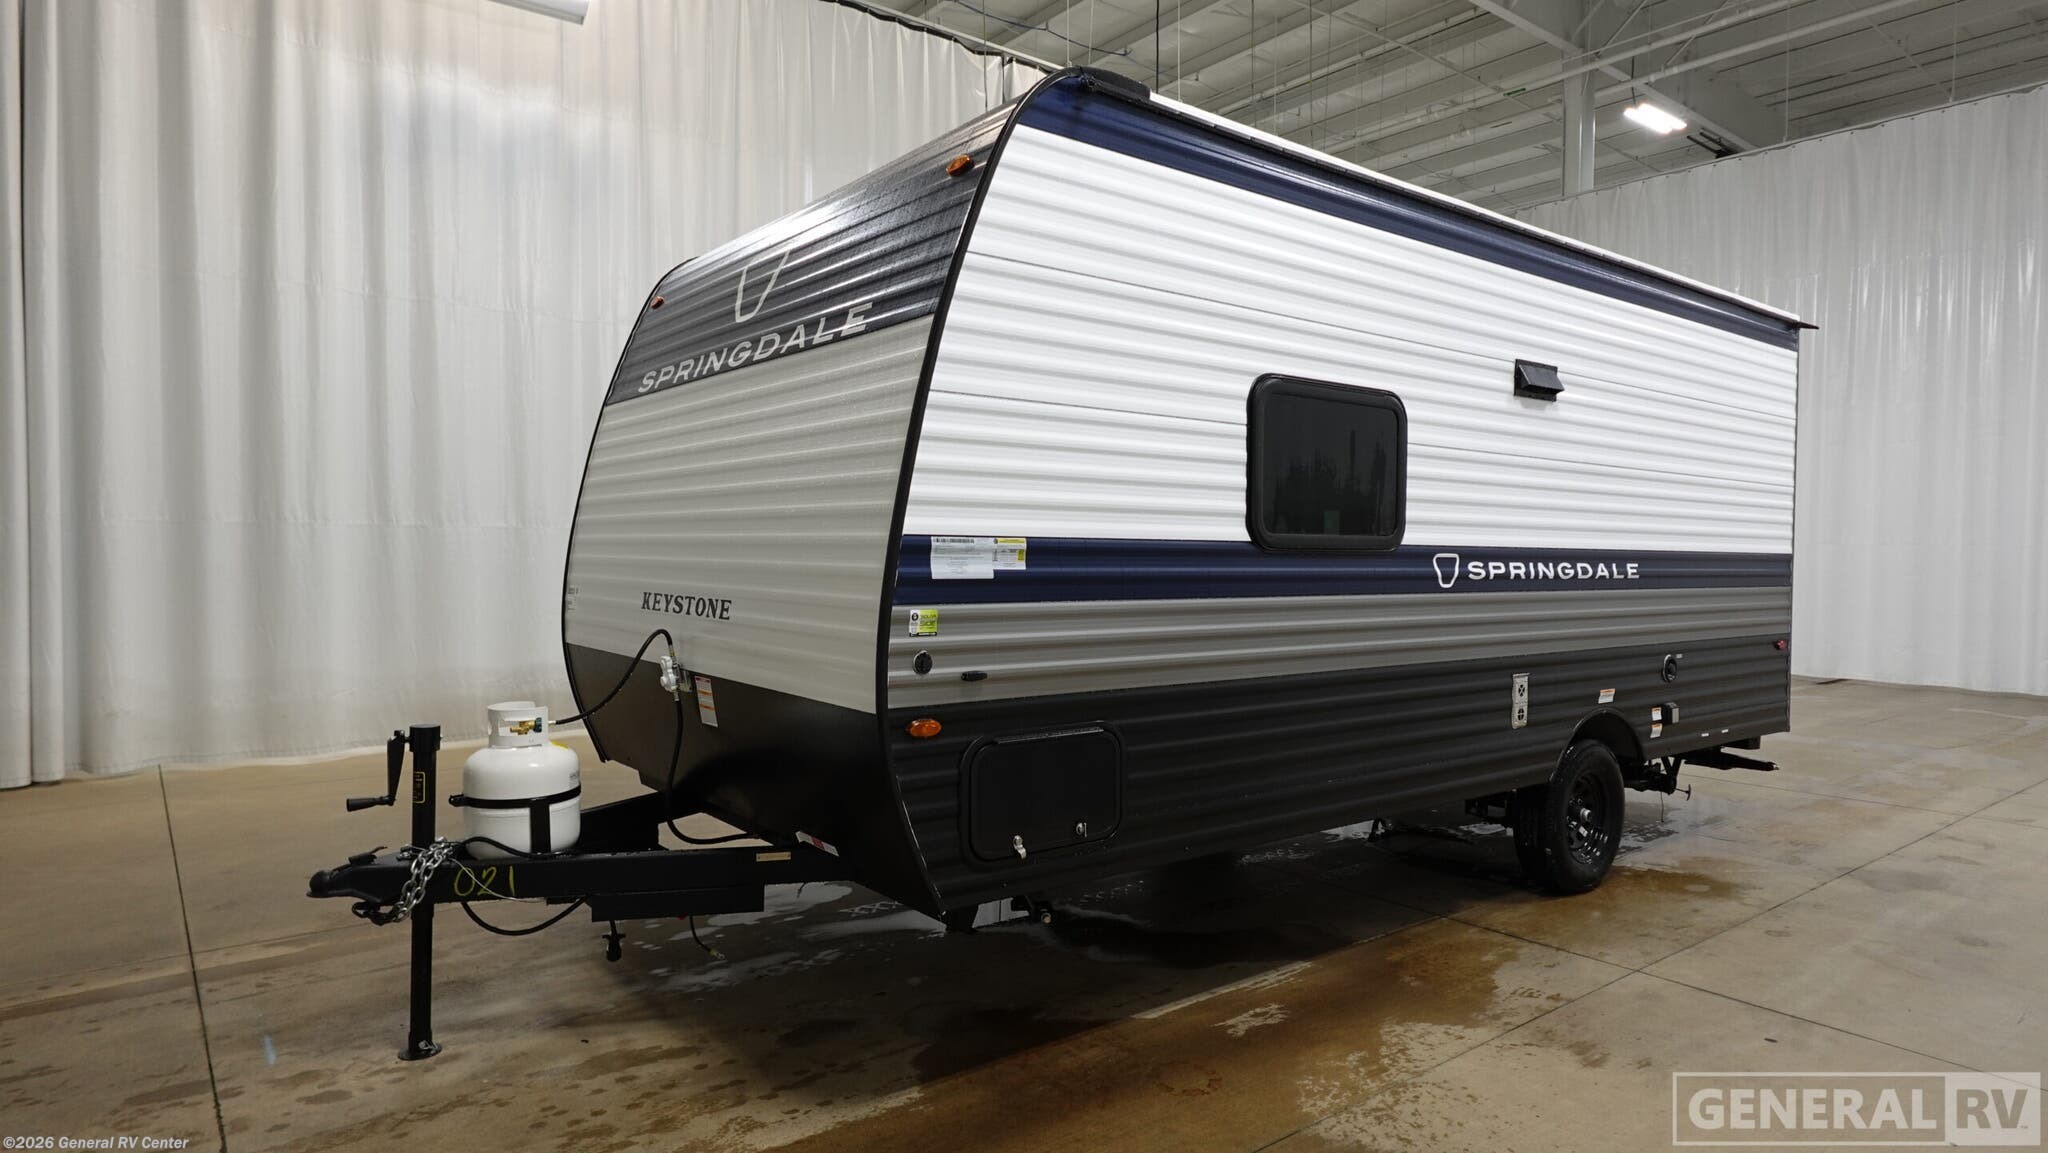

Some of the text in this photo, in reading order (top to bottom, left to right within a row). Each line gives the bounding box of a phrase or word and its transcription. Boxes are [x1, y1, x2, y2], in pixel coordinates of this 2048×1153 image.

[638, 303, 873, 393] SPRINGDALE
[1467, 560, 1640, 580] SPRINGDALE
[641, 592, 732, 620] KEYSTONE
[454, 867, 516, 896] 021
